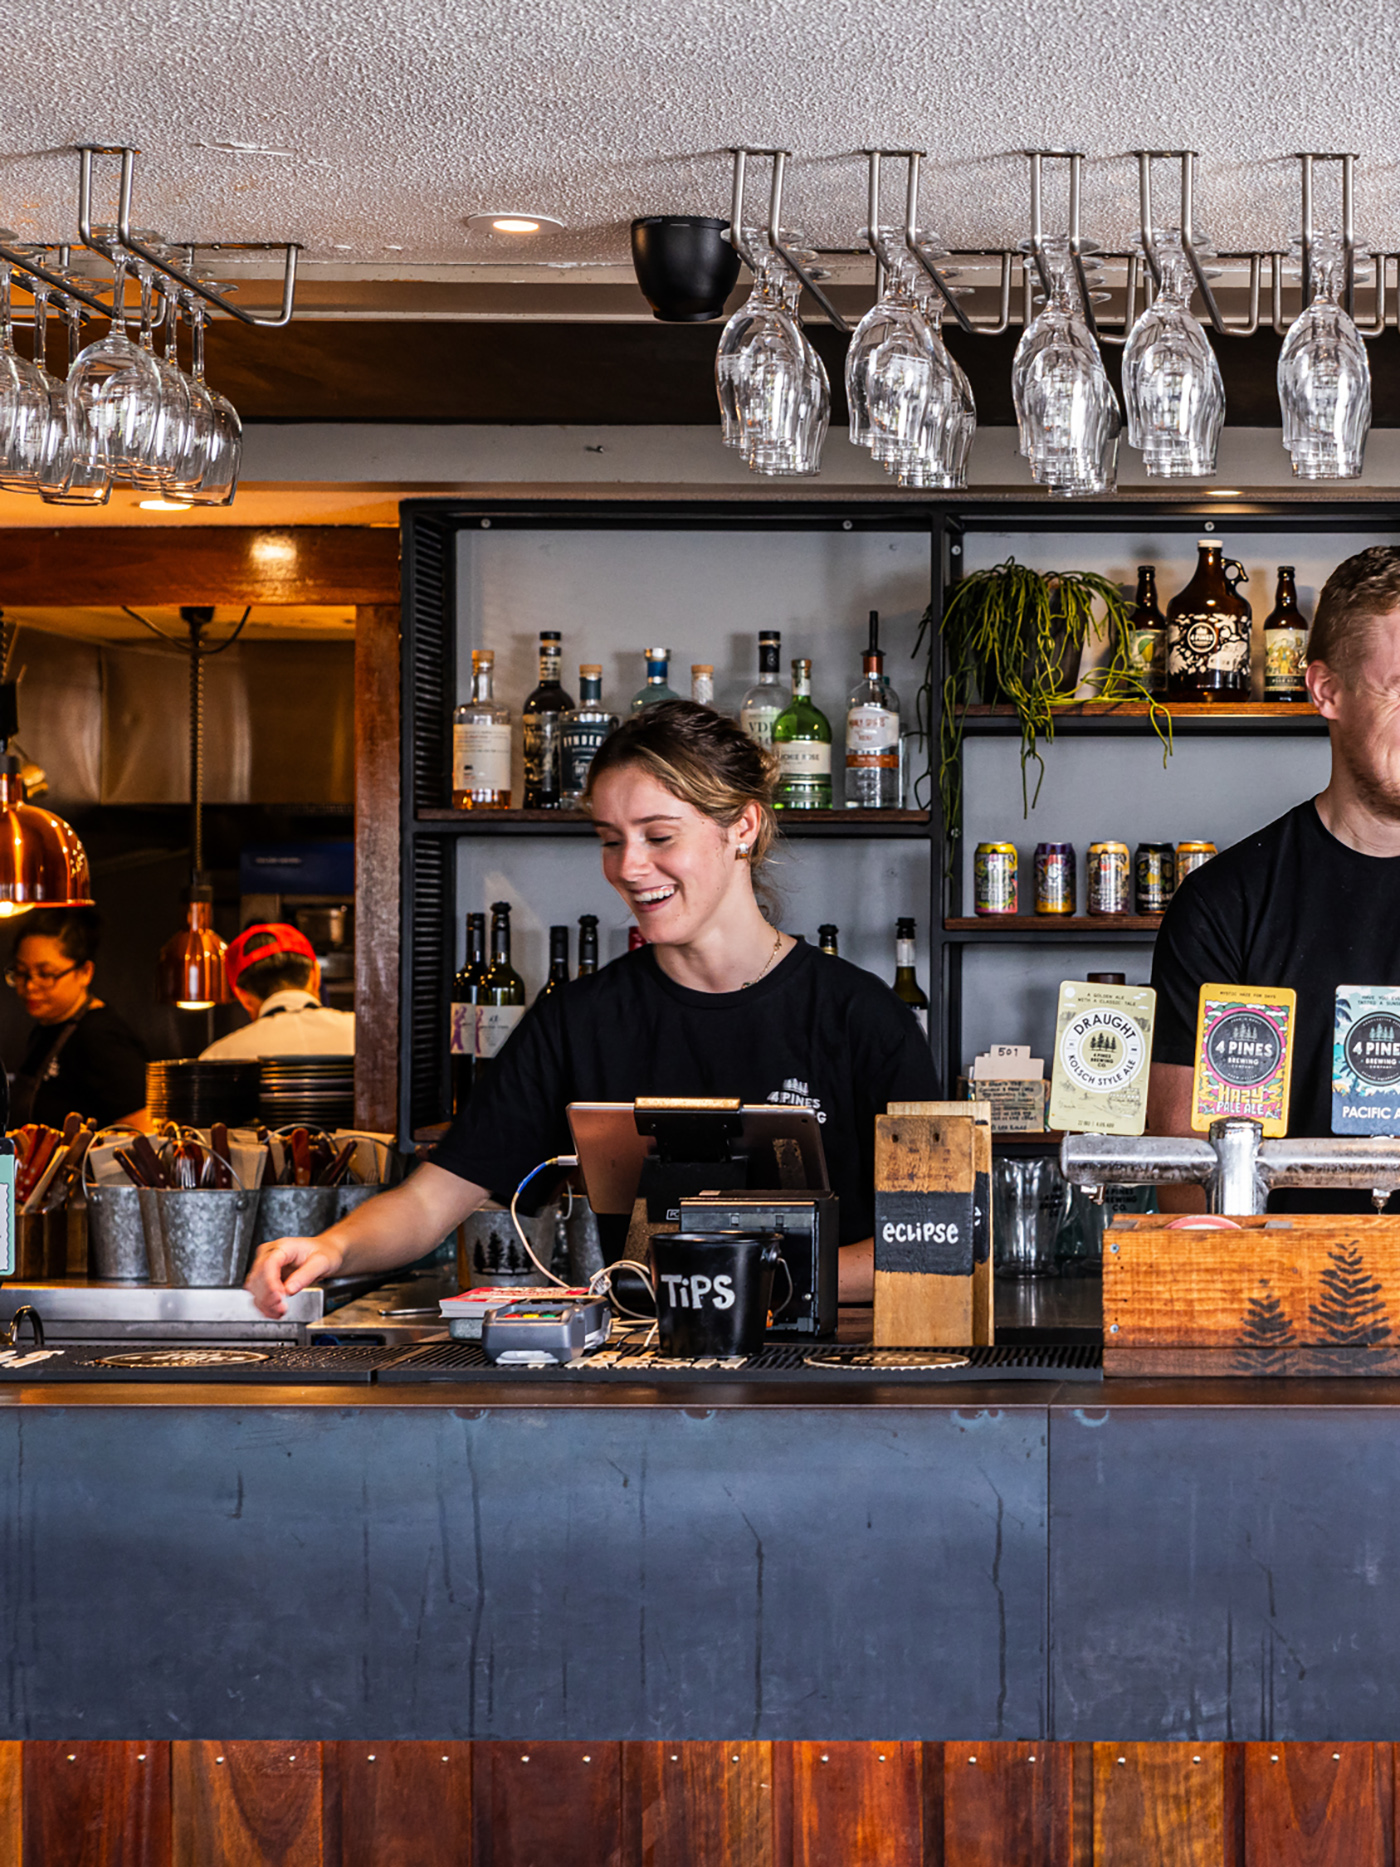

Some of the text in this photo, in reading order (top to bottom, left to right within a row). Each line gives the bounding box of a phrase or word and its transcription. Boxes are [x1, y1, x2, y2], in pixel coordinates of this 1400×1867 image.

[1073, 1013, 1137, 1040] DRAUGHT
[998, 1047, 1018, 1056] 501
[1215, 1040, 1273, 1057] 4 PINES
[1352, 1041, 1362, 1056] 4
[1227, 1057, 1259, 1066] BREWING
[1365, 1057, 1397, 1066] BREWING
[1097, 1073, 1123, 1086] STYLE
[1124, 1059, 1136, 1076] ALE
[767, 1091, 821, 1109] 4 PINES
[1218, 1082, 1265, 1104] HAZY
[1216, 1102, 1264, 1115] PALE ALE
[1342, 1106, 1391, 1119] PACIFIC
